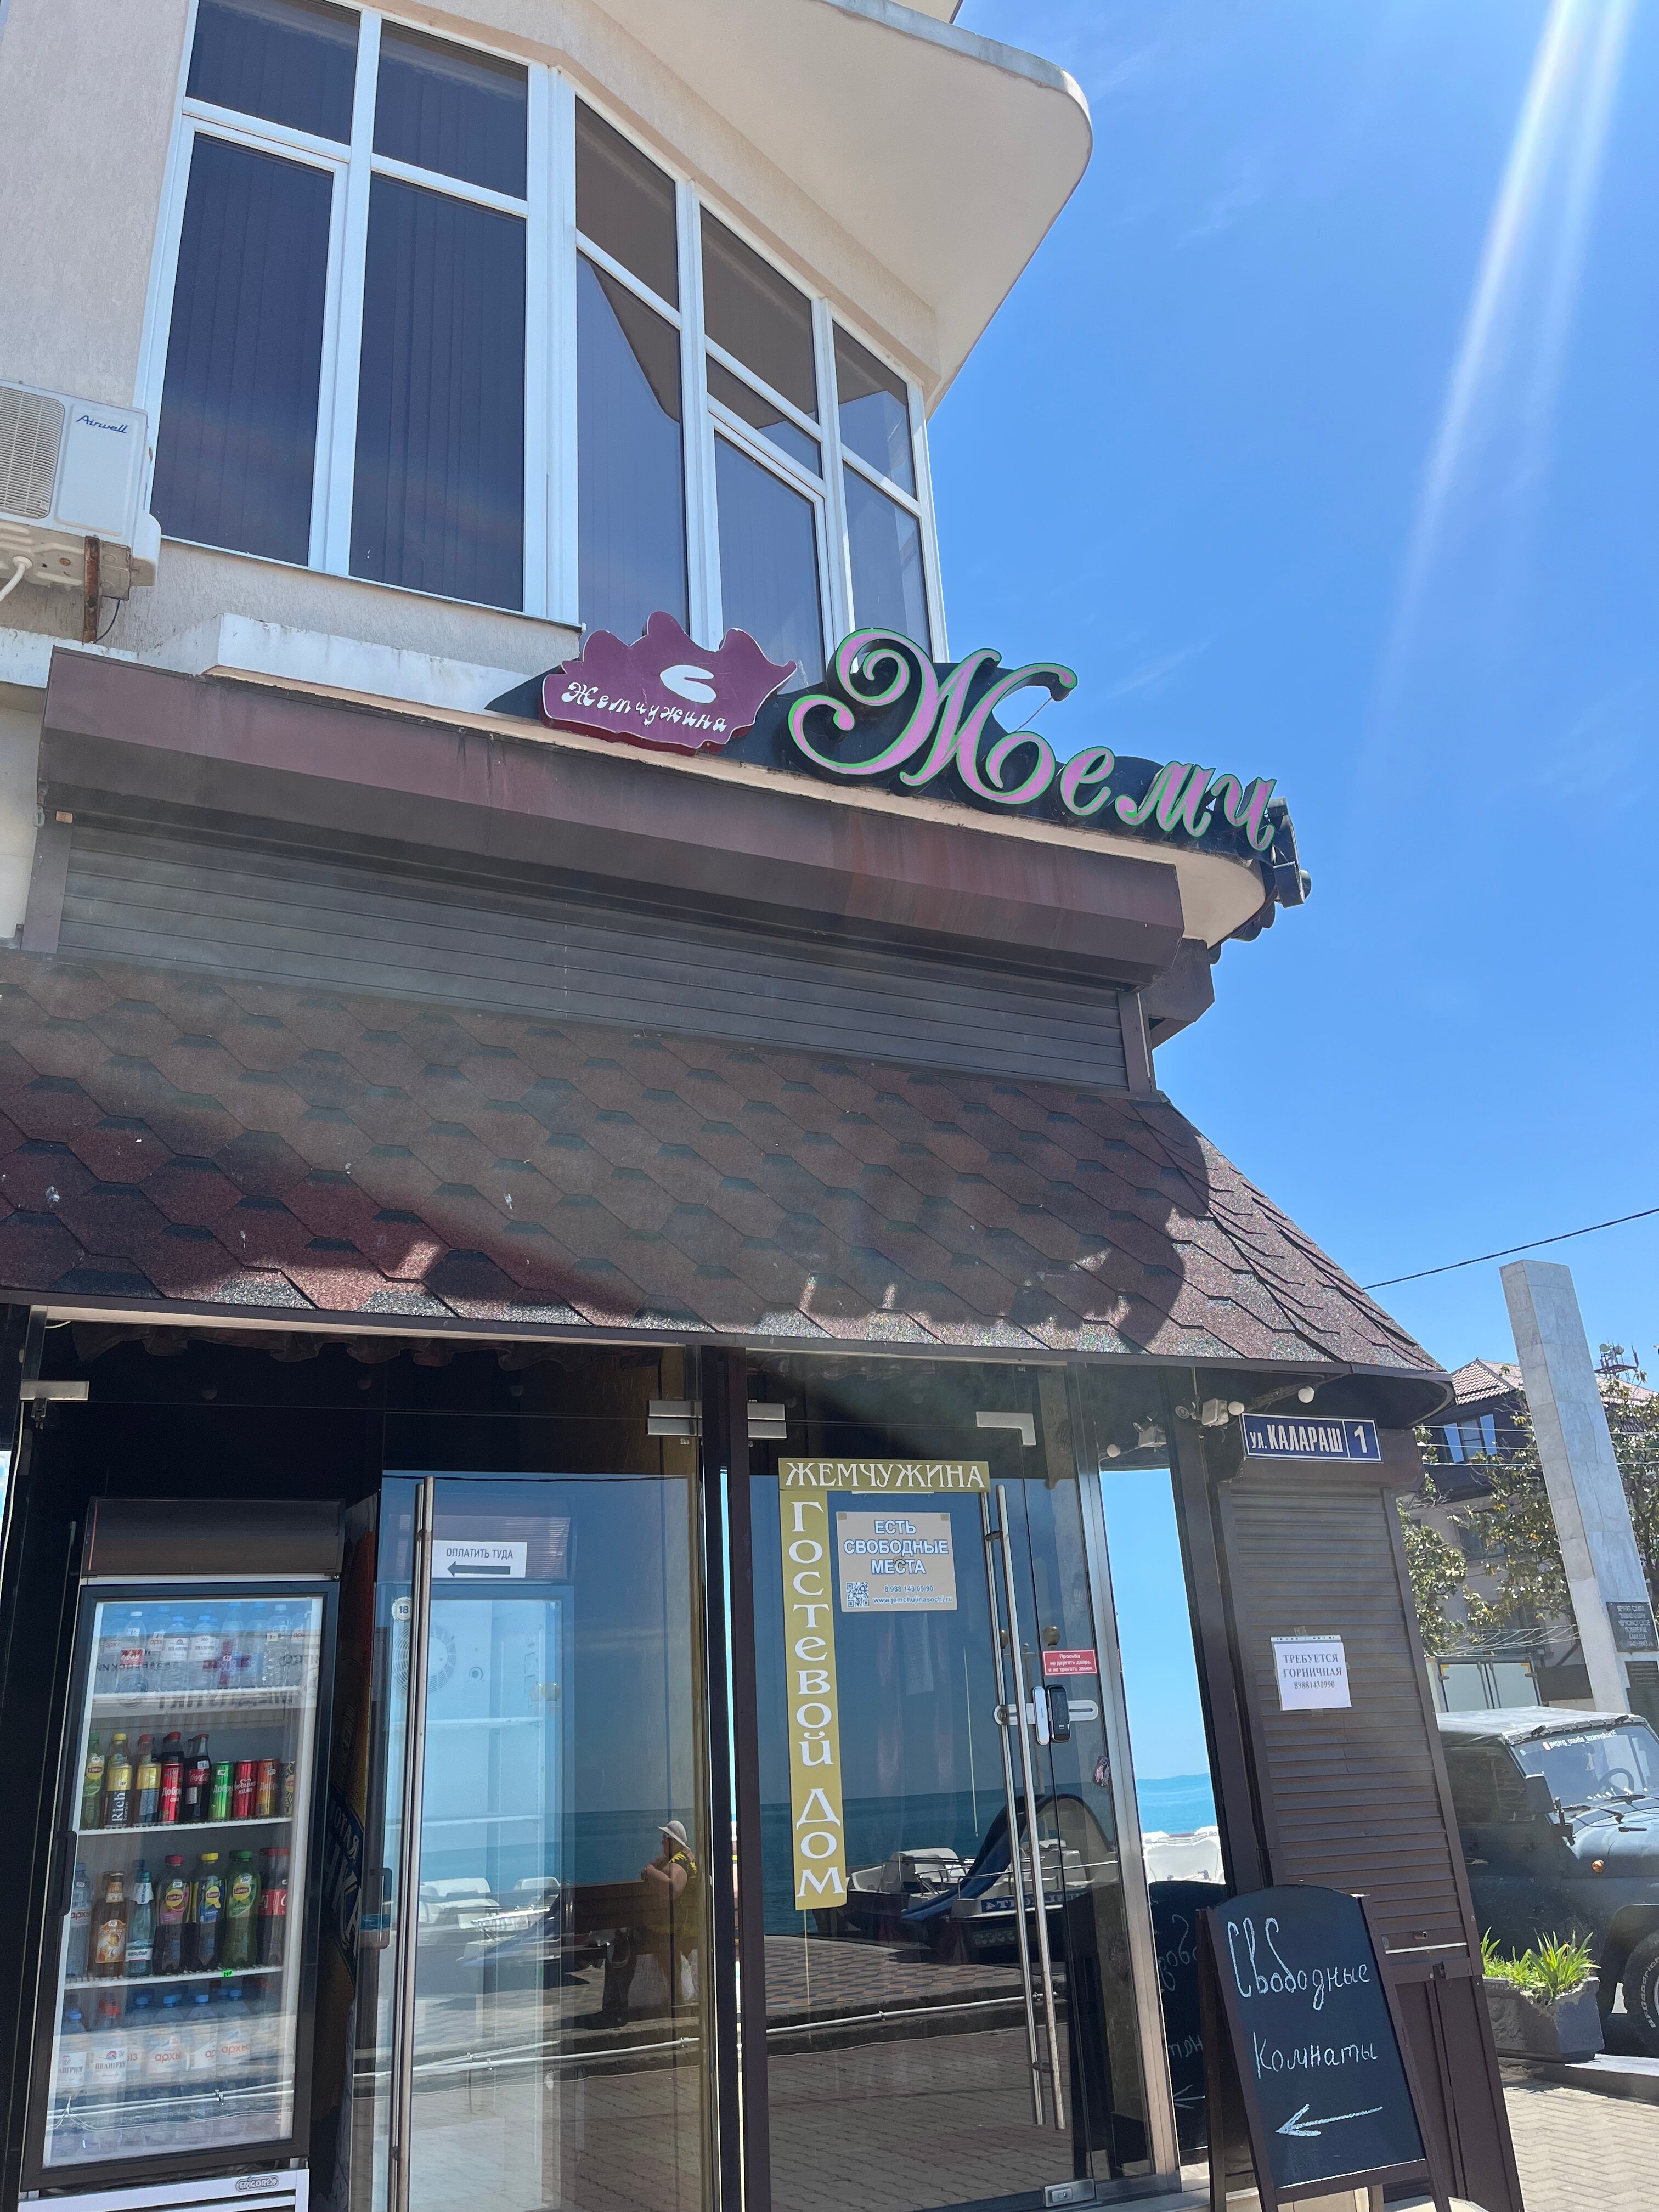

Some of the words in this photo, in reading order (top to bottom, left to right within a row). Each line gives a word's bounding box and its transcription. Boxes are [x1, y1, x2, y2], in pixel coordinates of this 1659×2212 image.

[76, 414, 128, 434] Airwell
[561, 681, 727, 732] Жемчужина
[1267, 1424, 1344, 1453] КАЛАРАШ
[1354, 1425, 1368, 1453] 1
[785, 1462, 985, 1488] ЖЕМЧУЖИНА
[874, 1520, 916, 1534] ЕСТЬ
[446, 1548, 489, 1559] ОПЛАТИТЬ
[492, 1549, 514, 1560] ТУДА
[844, 1539, 949, 1557] СВОБОДНЫЕ
[871, 1559, 927, 1574] МЕСТА
[873, 1596, 952, 1604] www.jemchujinasochi.ru
[399, 1605, 409, 1614] 18
[1283, 1654, 1338, 1663] ТРЕБУЕТСЯ
[1284, 1667, 1342, 1678] ГОРНИЧНАЯ
[1294, 1680, 1335, 1689] 89881430990
[111, 1790, 126, 1821] Rich
[1252, 2031, 1378, 2080] Комнаты
